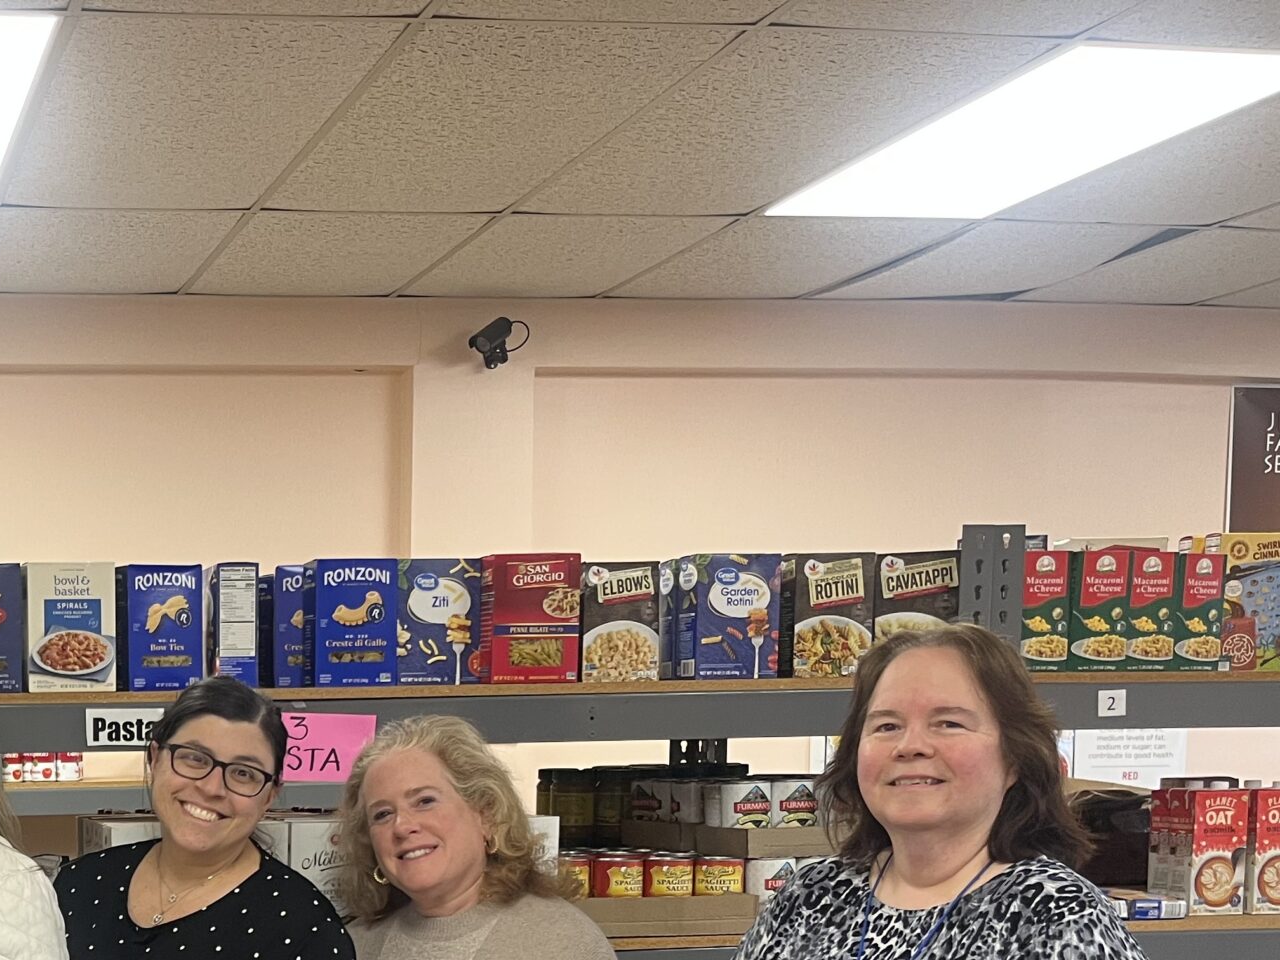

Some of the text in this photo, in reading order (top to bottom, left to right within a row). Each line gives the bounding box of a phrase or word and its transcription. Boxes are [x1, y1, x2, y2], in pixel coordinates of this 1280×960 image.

[526, 565, 550, 574] SAN
[54, 575, 90, 585] bowl &
[135, 572, 195, 590] RONZONI
[324, 568, 390, 586] RONZONI
[513, 573, 564, 587] GIORGIO
[814, 573, 857, 583] TRI-COLOR
[887, 566, 953, 592] CAVATAPPI
[1086, 576, 1123, 584] Macaroni
[1133, 577, 1169, 585] Macaroni
[283, 575, 302, 592] RO
[603, 575, 651, 596] ELBOWS
[816, 578, 859, 600] ROTINI
[54, 586, 90, 596] basket
[721, 587, 759, 596] Garden
[432, 597, 448, 608] Ziti
[727, 597, 753, 606] Rotini
[326, 639, 353, 647] Creste
[1107, 697, 1115, 710] 2
[288, 716, 309, 740] 3
[287, 746, 340, 772] STA
[1122, 772, 1138, 780] RED
[1206, 797, 1237, 808] PLANET
[1268, 797, 1280, 807] PLA
[1206, 811, 1235, 825] OAT
